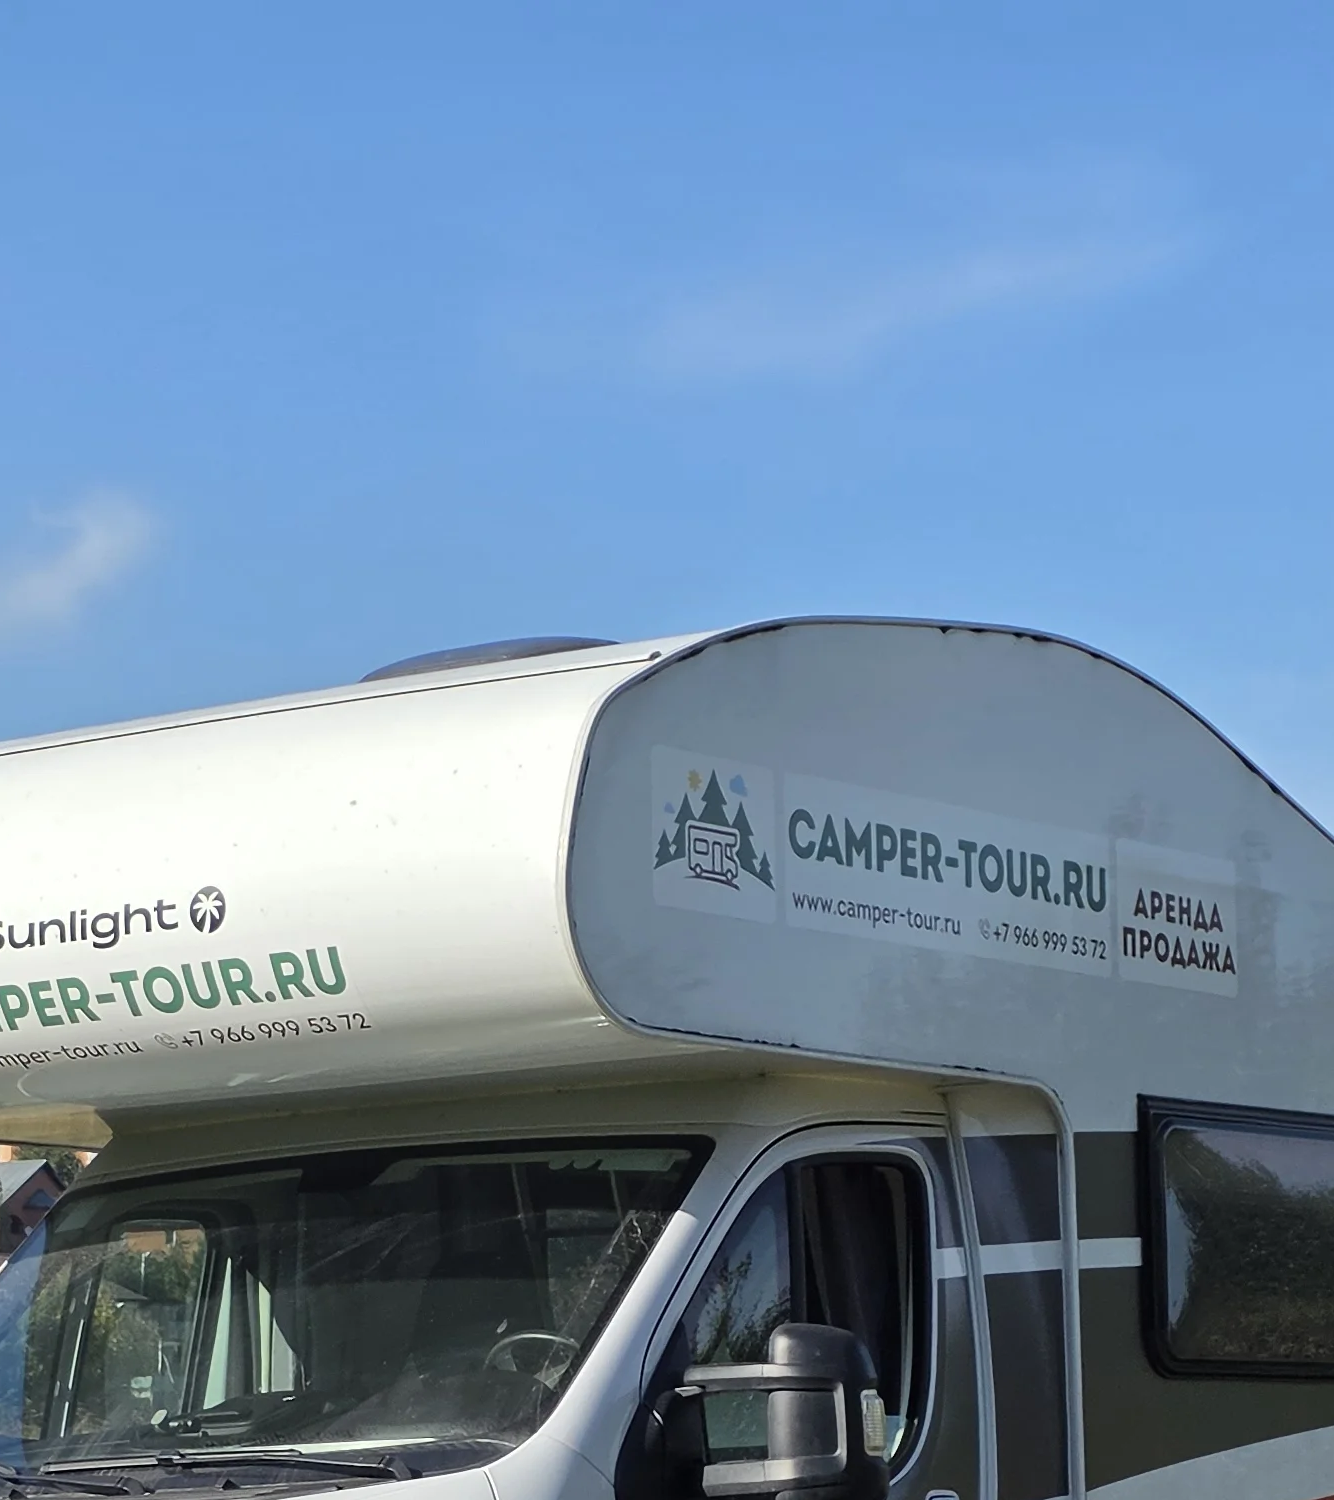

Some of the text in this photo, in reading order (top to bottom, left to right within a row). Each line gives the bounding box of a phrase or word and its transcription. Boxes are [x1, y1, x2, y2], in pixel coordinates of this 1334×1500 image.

[789, 809, 1108, 912] CAMPER-TOUR.RU
[792, 892, 961, 935] www.camper-tour.ru
[1134, 889, 1224, 933] АРЕНДА
[993, 924, 1107, 960] +7 966 999 53 72
[1122, 926, 1237, 976] ПРОДАЖА
[181, 1012, 372, 1048] +7 966 999 53 72
